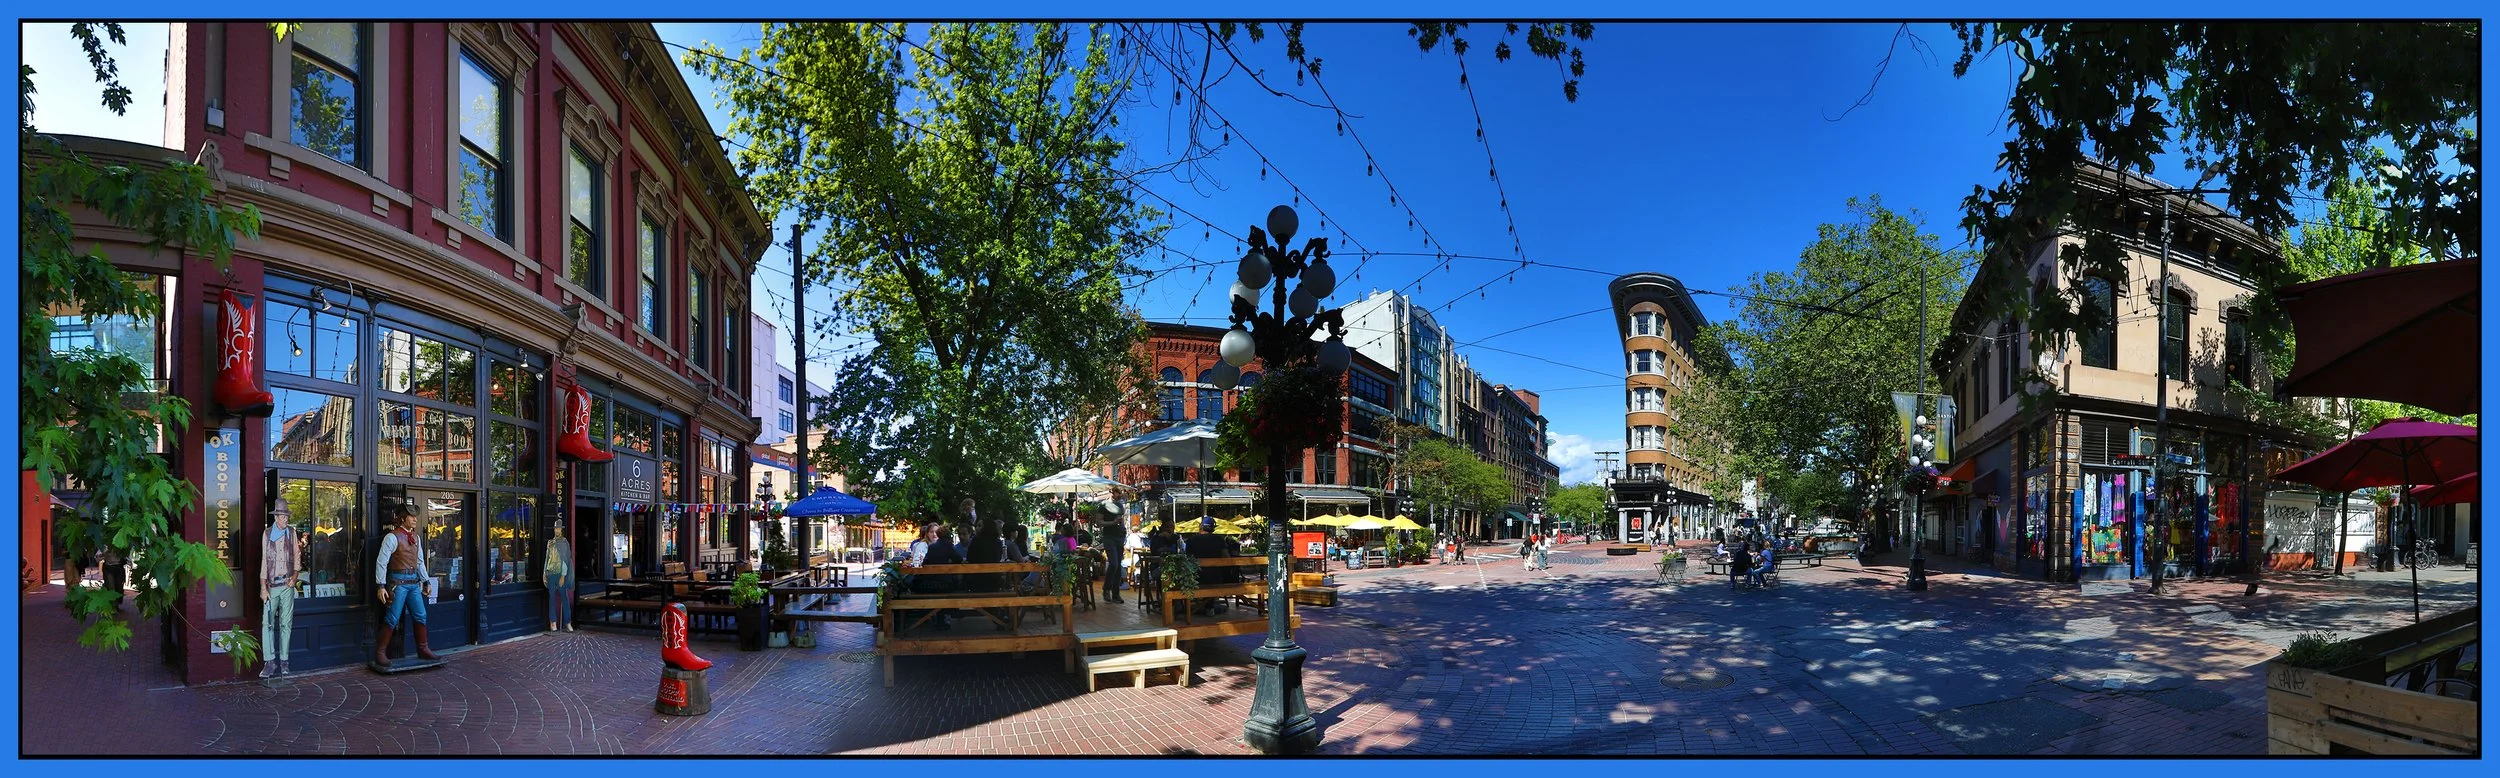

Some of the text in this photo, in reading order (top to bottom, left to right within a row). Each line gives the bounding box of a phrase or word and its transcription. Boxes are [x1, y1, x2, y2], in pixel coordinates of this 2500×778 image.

[632, 459, 641, 478] 6
[555, 471, 565, 481] OK
[621, 478, 650, 490] ACRES
[210, 433, 234, 559] OK BOOT CORRAL
[441, 491, 455, 500] 205
